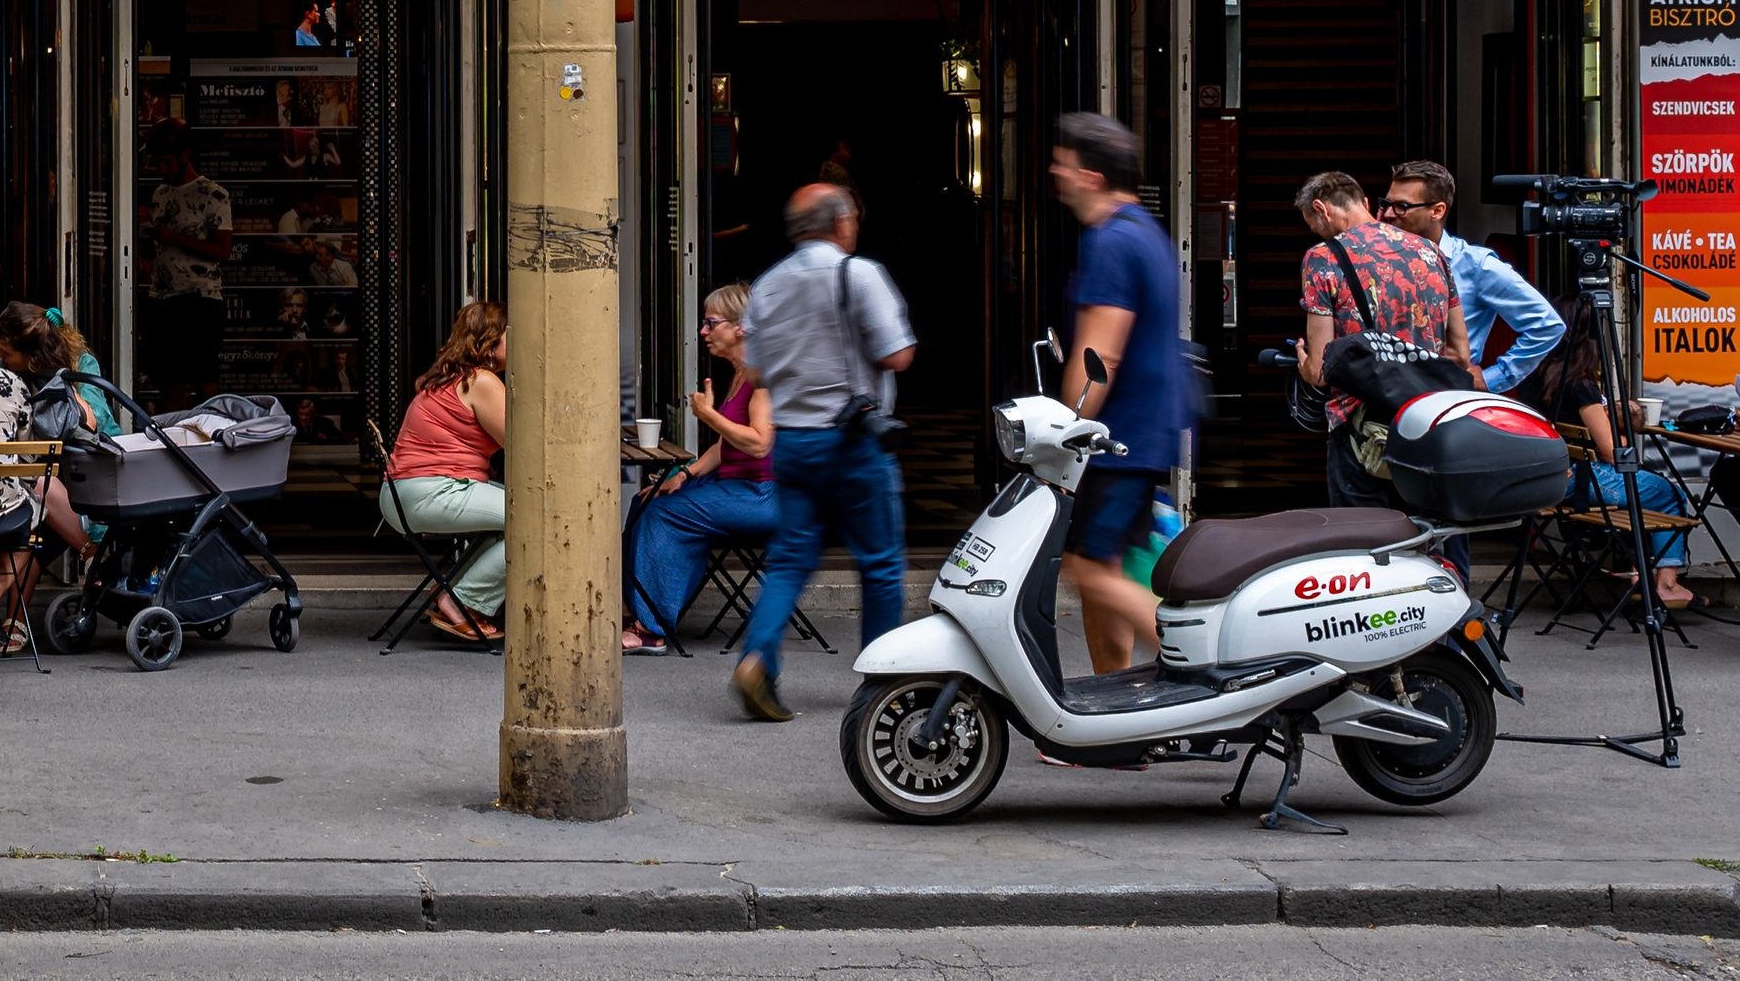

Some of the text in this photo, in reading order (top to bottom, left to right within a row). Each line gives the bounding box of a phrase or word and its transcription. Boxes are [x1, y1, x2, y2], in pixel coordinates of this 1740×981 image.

[1650, 2, 1736, 27] BISZTRÓ
[1651, 54, 1736, 68] KÍNÁLATUNKBÓL:
[199, 84, 266, 98] Mefisztó
[1652, 100, 1735, 117] SZENDVICSEK
[1651, 149, 1735, 174] SZÖRPÖK
[1657, 174, 1735, 195] IMONÁDÉK
[1652, 229, 1737, 251] KÁVÉ TEA
[1652, 251, 1737, 270] CSOKOLÁDÉ
[1653, 306, 1736, 324] ALKOHOLOS
[1653, 327, 1737, 354] ITALOK
[1305, 606, 1426, 643] blinkee.city
[1364, 621, 1427, 643] 100% ELECTRIC
